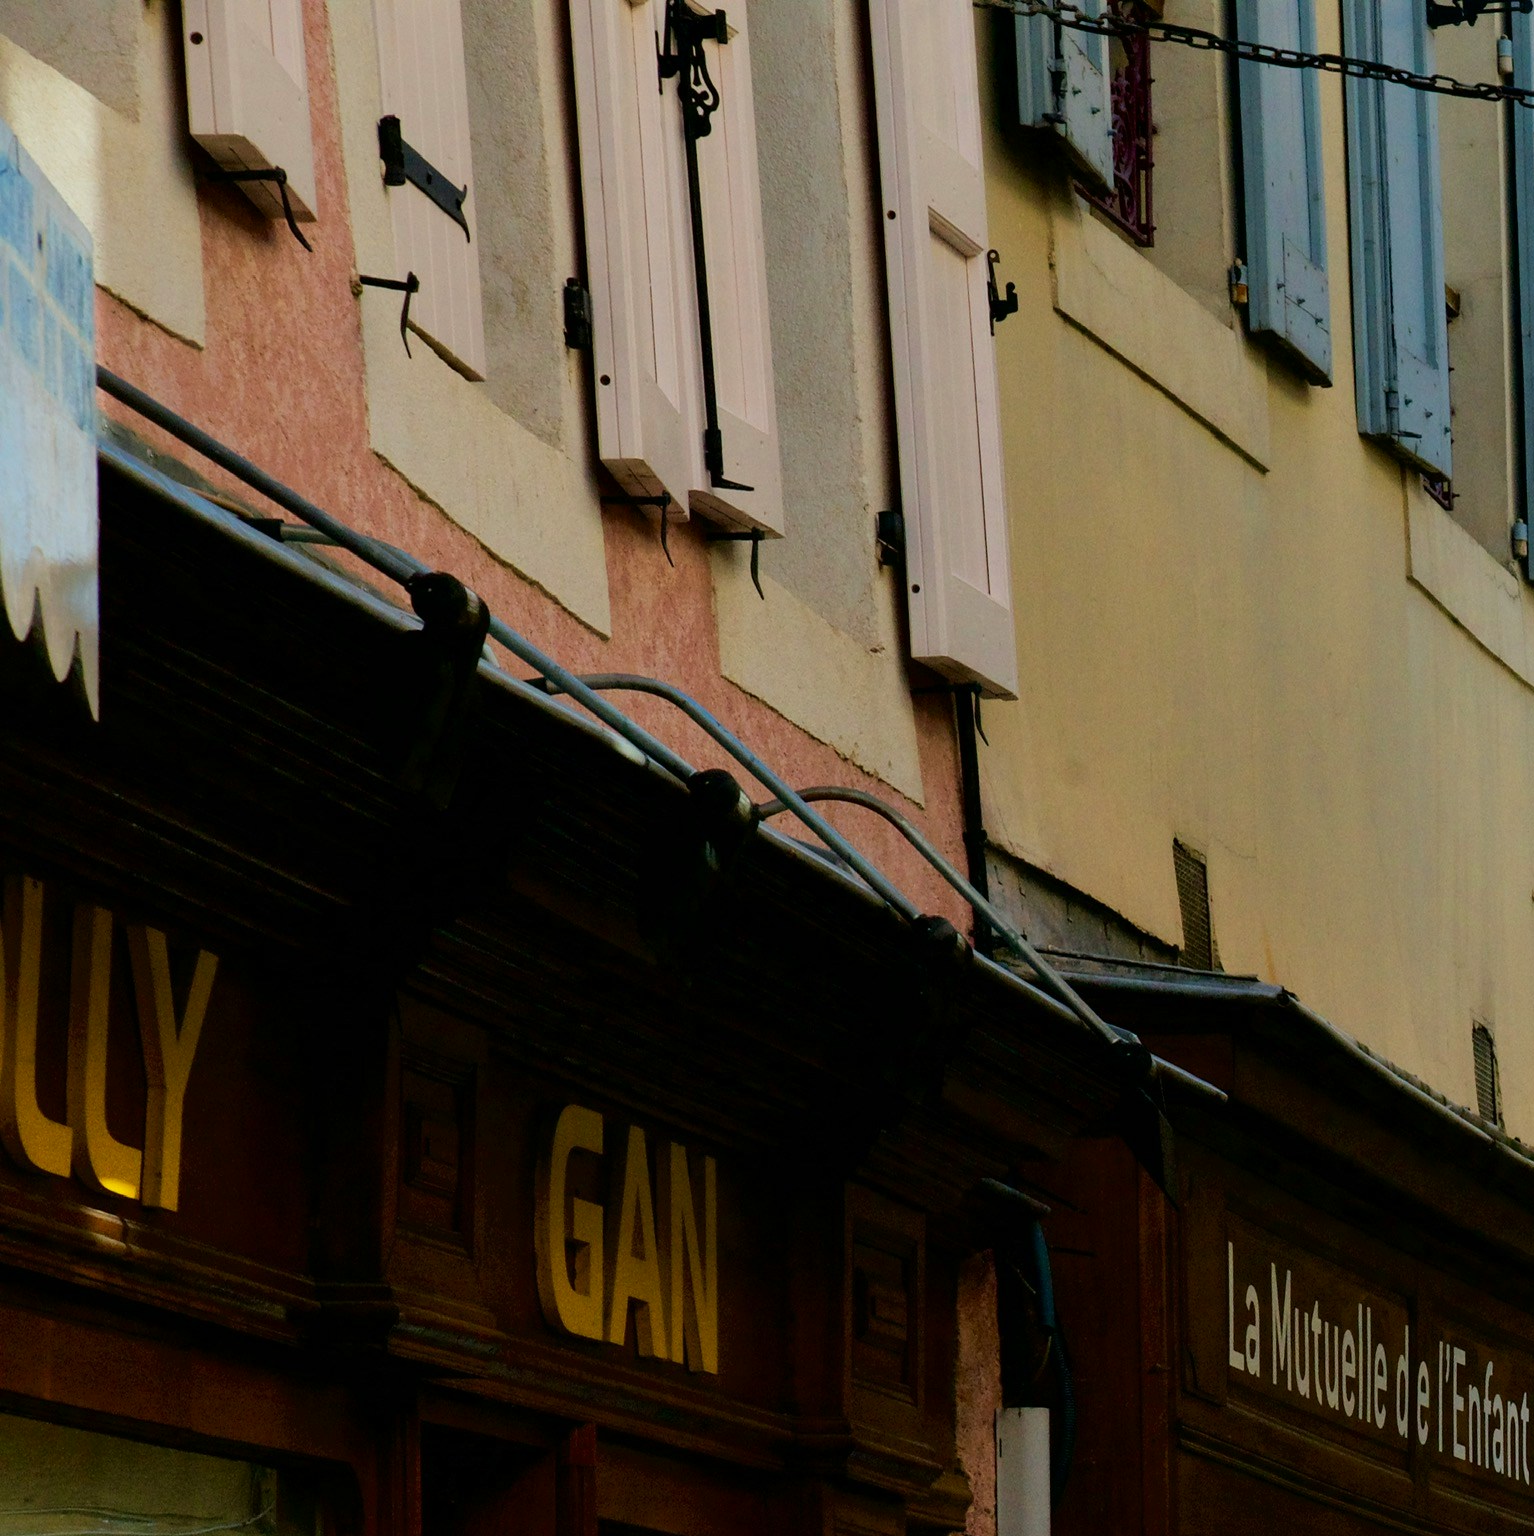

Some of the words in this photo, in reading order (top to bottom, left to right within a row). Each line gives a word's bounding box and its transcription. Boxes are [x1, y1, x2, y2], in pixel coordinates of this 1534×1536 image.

[0, 874, 219, 1213] LLY
[535, 1104, 721, 1376] GAN
[1228, 1240, 1260, 1378] La
[1271, 1262, 1388, 1430] Mutuelle
[1438, 1340, 1530, 1487] l'Enfant
